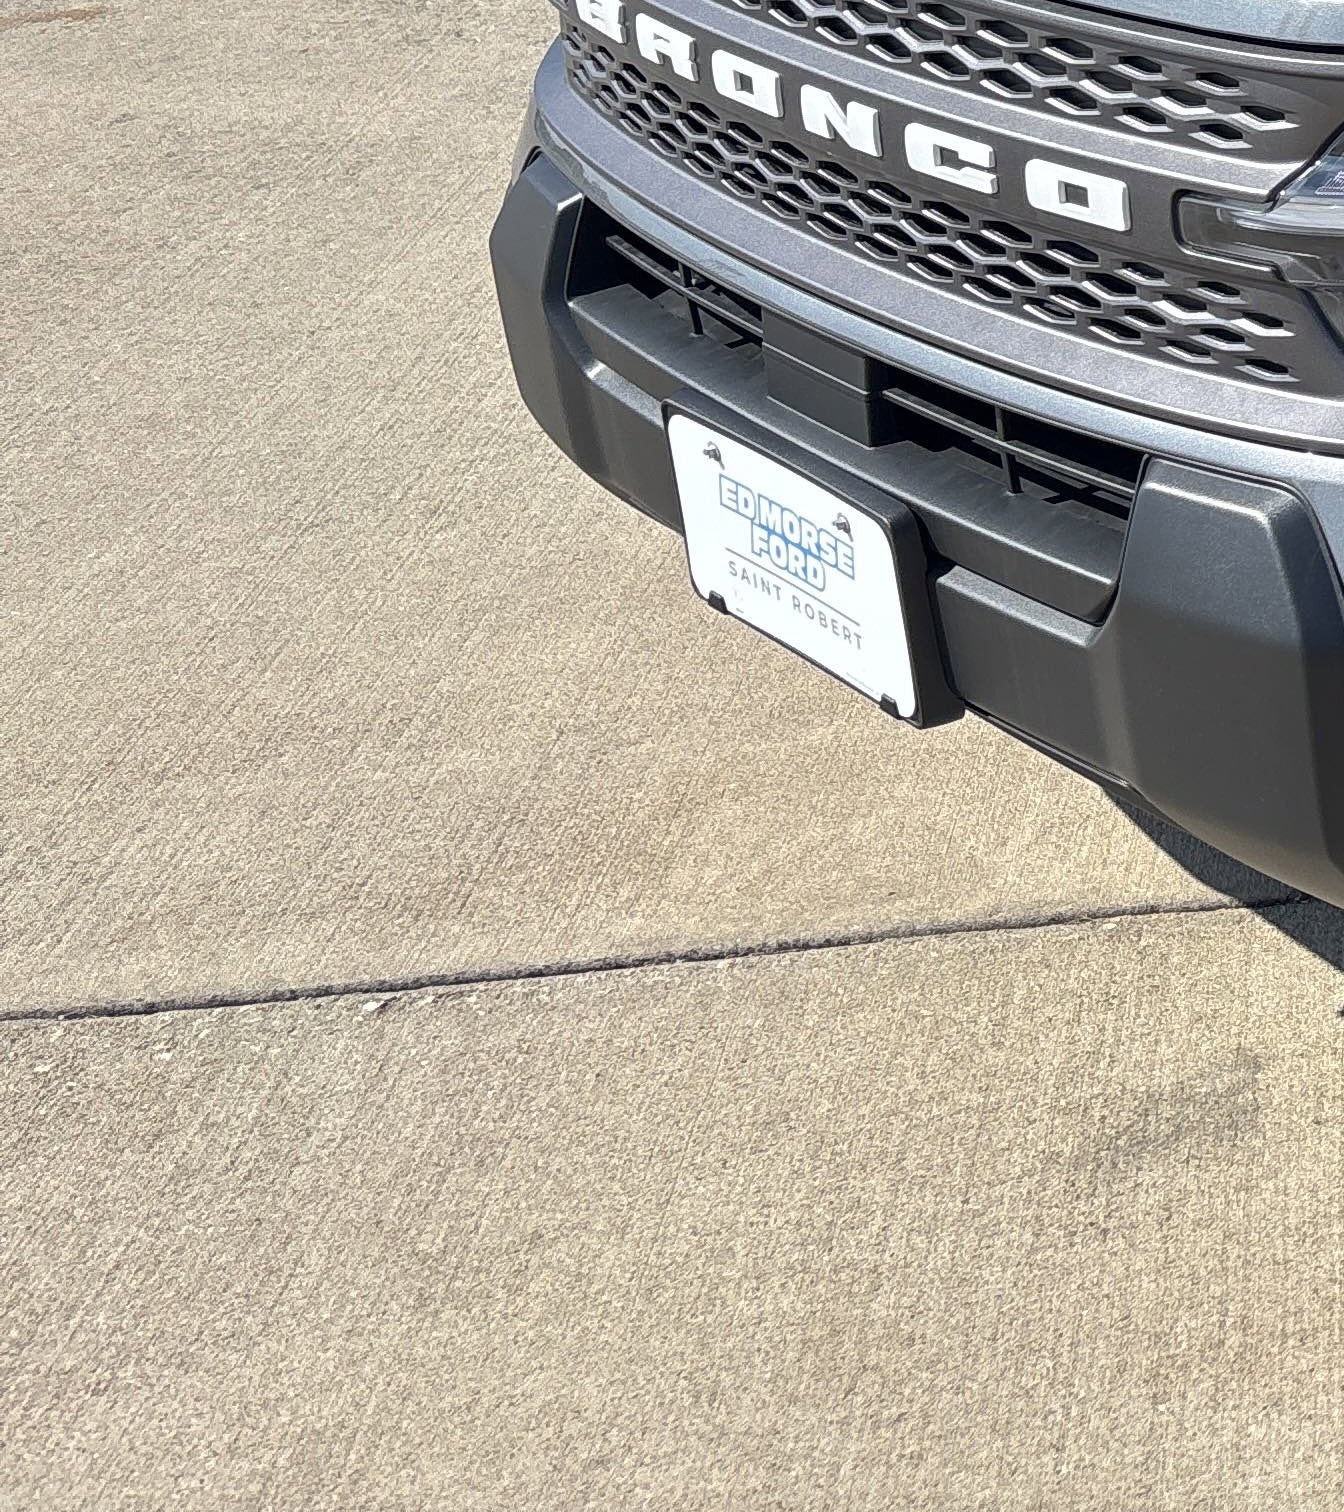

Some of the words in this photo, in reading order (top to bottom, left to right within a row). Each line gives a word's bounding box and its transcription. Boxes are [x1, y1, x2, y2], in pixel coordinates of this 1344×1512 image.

[719, 473, 756, 522] ED
[757, 493, 855, 580] MORSE
[751, 520, 826, 592] FORD
[728, 560, 782, 601] SAINT
[793, 595, 862, 650] ROBERT
